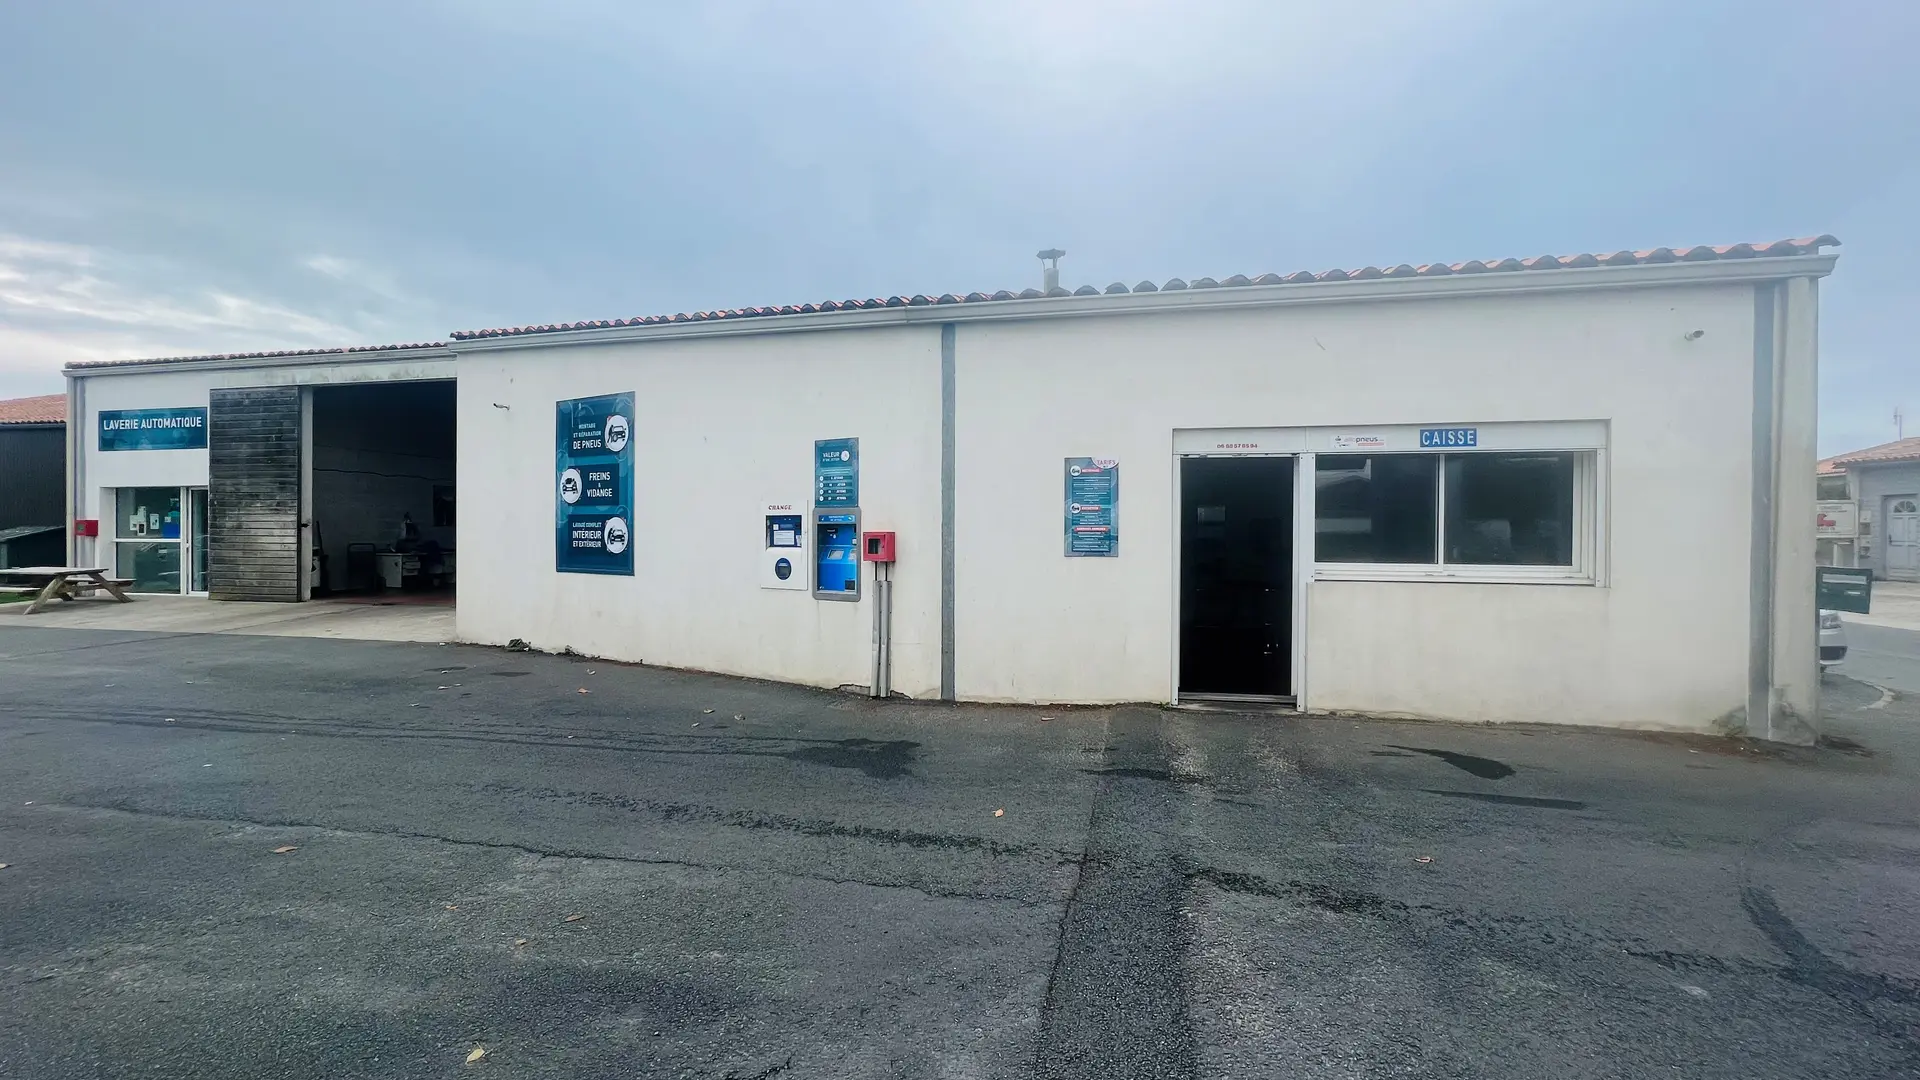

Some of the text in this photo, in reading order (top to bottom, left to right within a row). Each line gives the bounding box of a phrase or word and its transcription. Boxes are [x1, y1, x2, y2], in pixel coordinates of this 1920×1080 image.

[103, 417, 202, 431] LAVERIE AUTOMATIQUE
[1422, 430, 1474, 445] CAISSE
[573, 440, 602, 450] DE PNEUS
[588, 472, 610, 481] FREINS
[586, 488, 612, 498] VIDANGE
[572, 528, 602, 539] INTÉRIEUR
